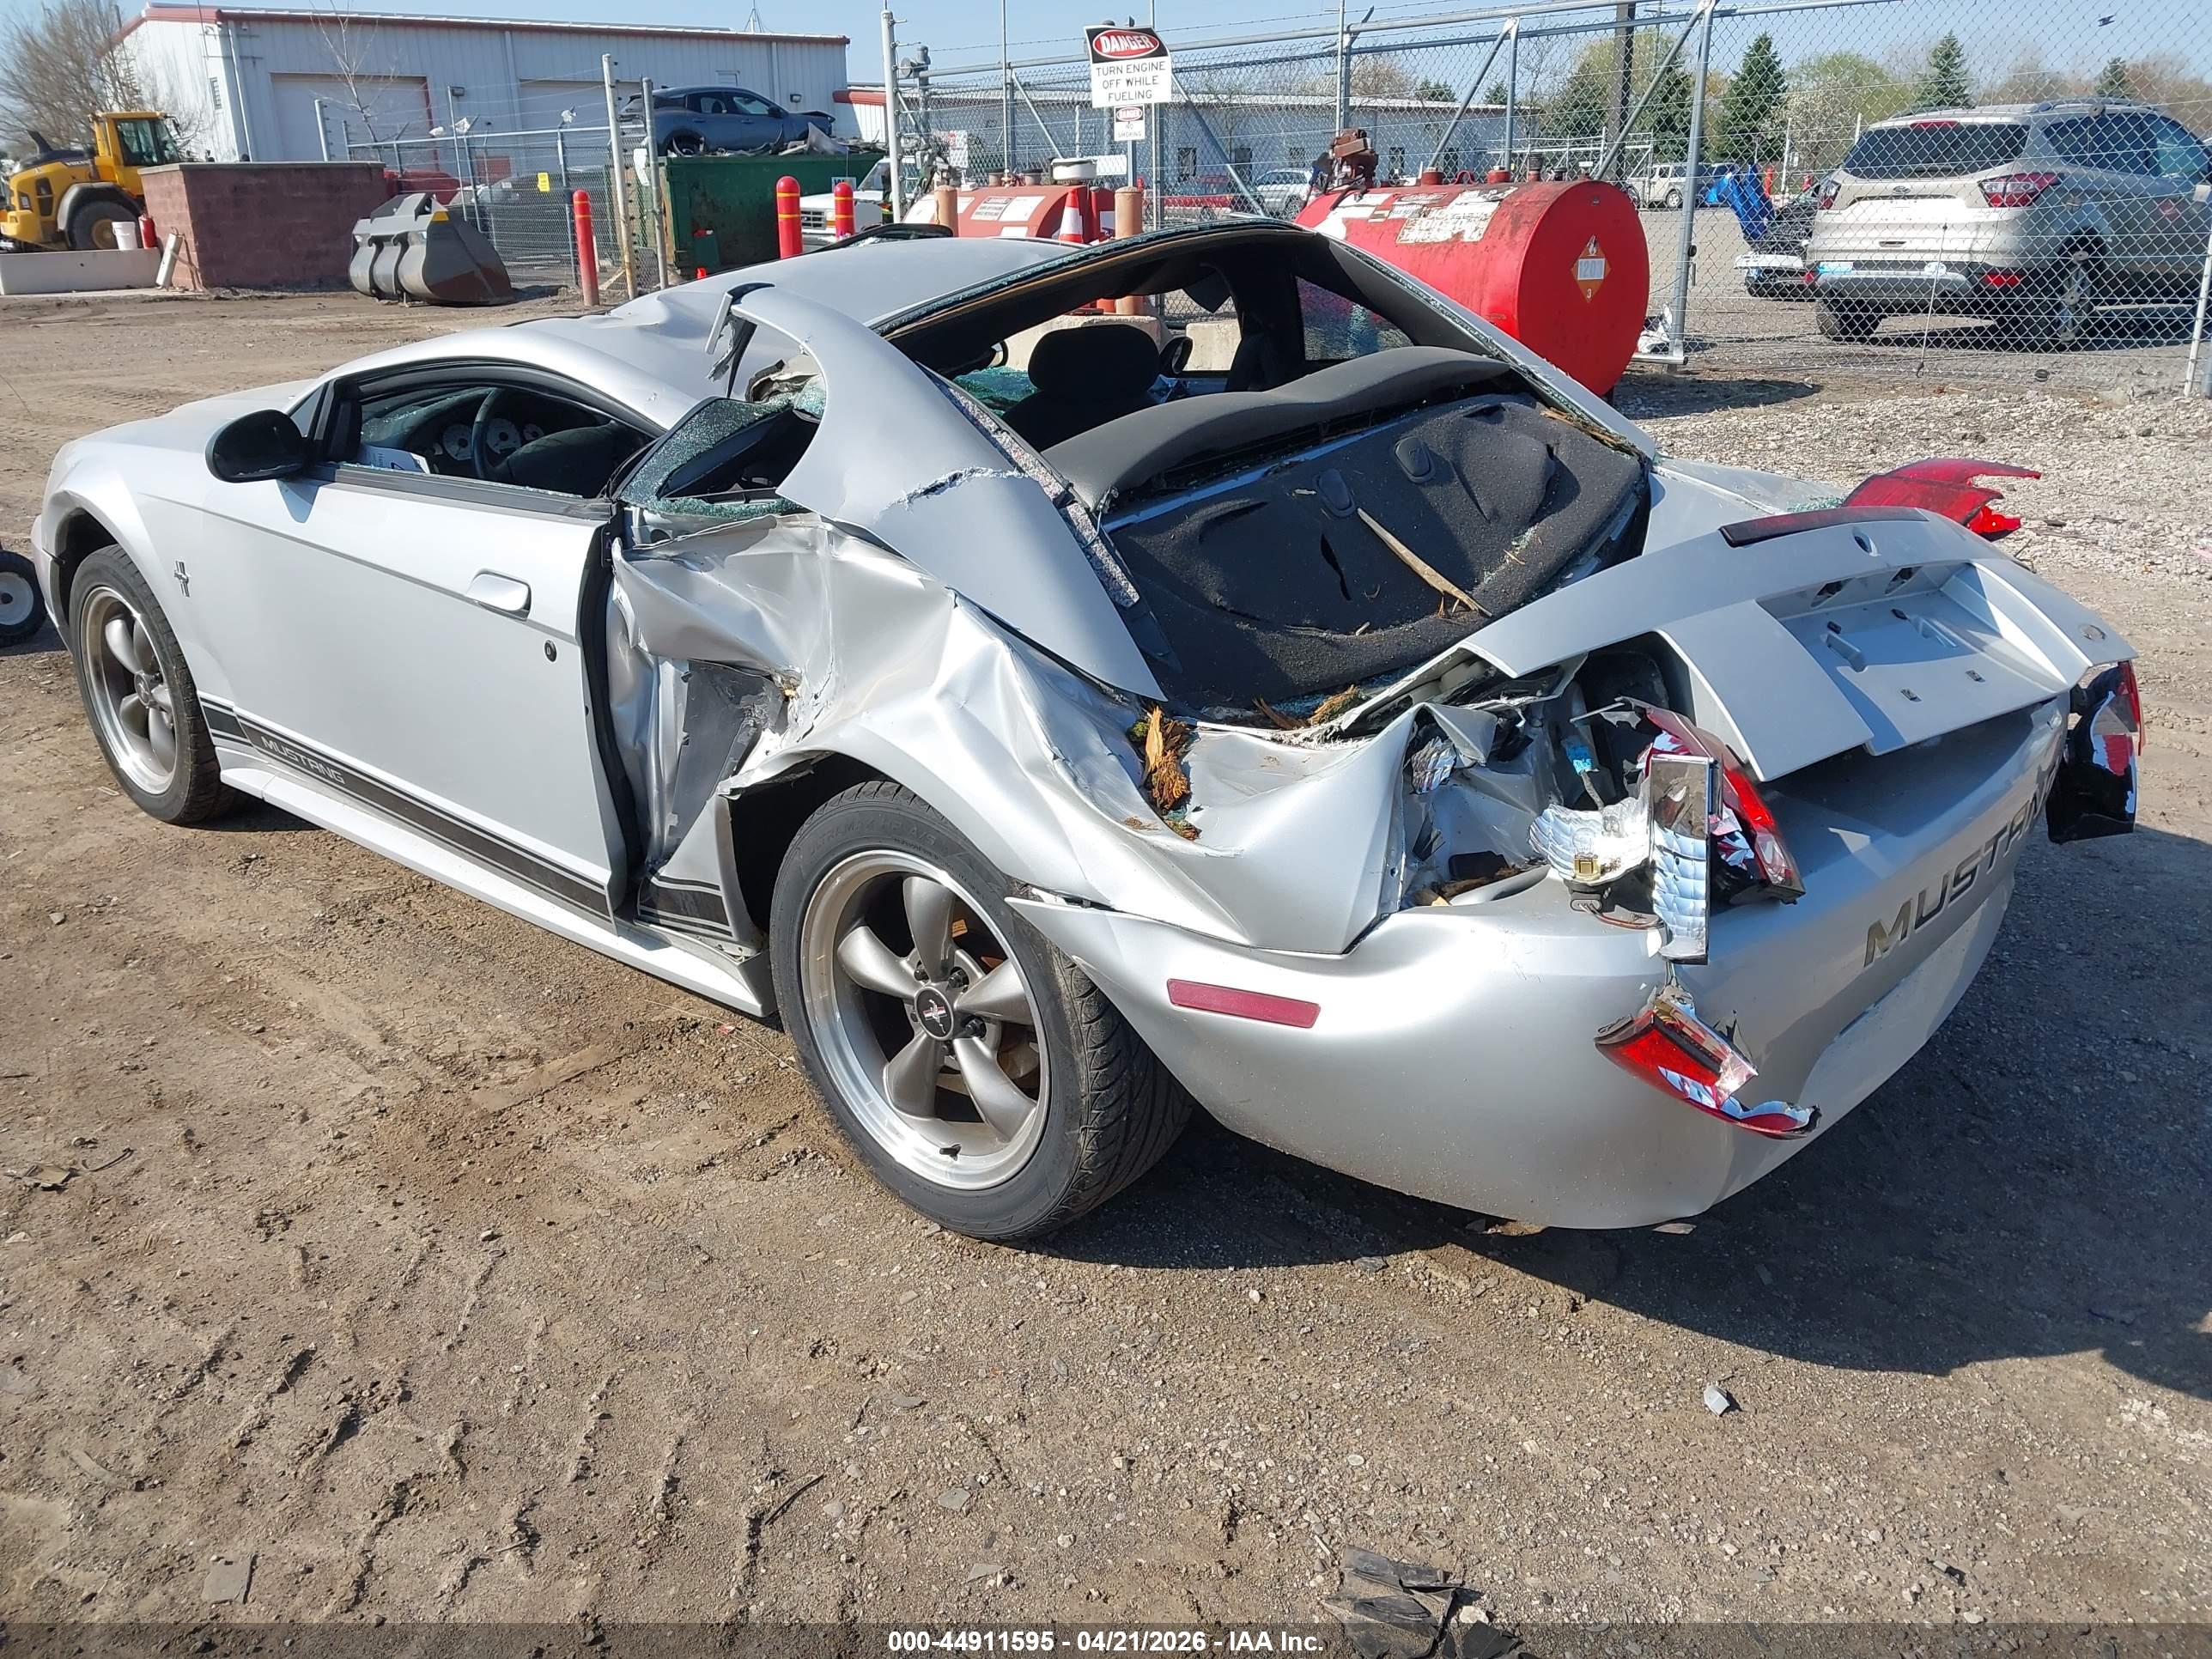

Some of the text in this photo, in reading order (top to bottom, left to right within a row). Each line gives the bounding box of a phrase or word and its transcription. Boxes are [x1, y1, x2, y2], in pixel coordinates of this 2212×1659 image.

[1100, 34, 1154, 54] DANGER
[1096, 61, 1166, 76] TURN ENGINE
[1103, 76, 1159, 89] OFF WHILE
[1108, 89, 1153, 102] FUELING
[1586, 288, 1592, 299] 3
[261, 736, 345, 784] MUSTANG
